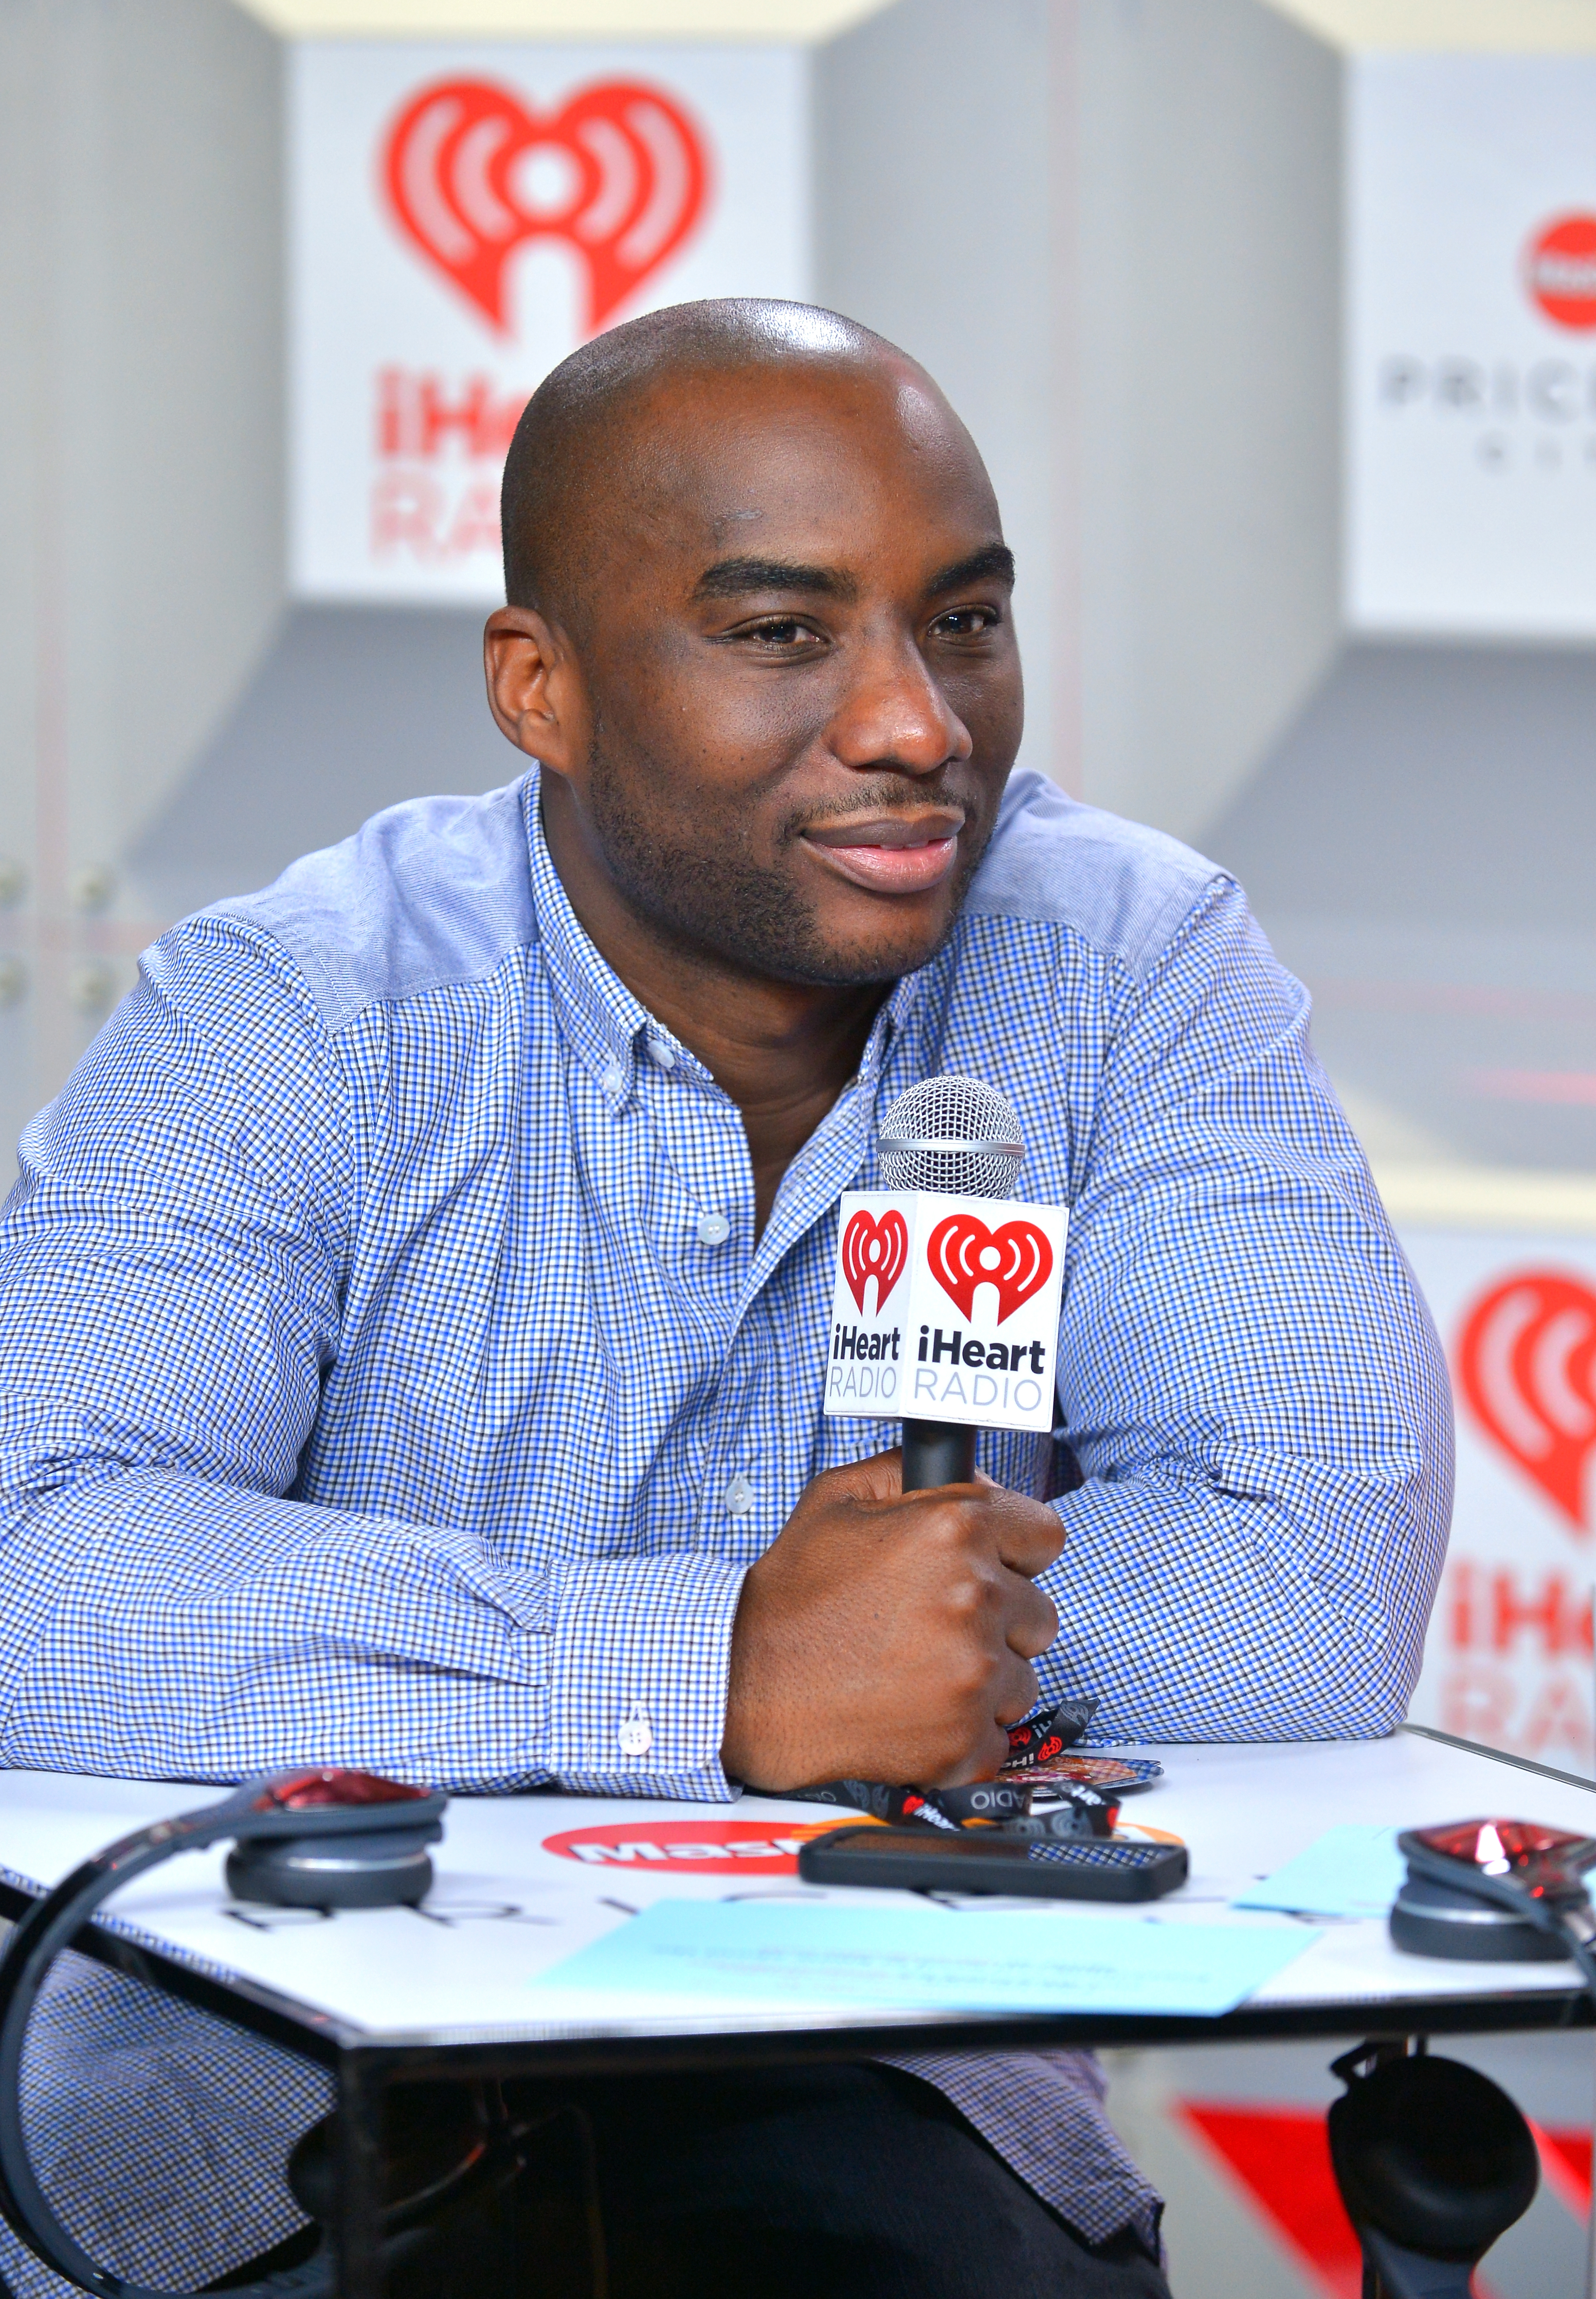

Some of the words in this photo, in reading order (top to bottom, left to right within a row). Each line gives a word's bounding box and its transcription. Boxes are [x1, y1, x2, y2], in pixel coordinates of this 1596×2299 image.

[1375, 353, 1596, 424] PRIC
[373, 472, 504, 560] RA
[833, 1323, 901, 1361] iHeart
[918, 1324, 1046, 1375] iHeart
[829, 1366, 897, 1399] RADIO
[914, 1368, 1042, 1412] RADIO
